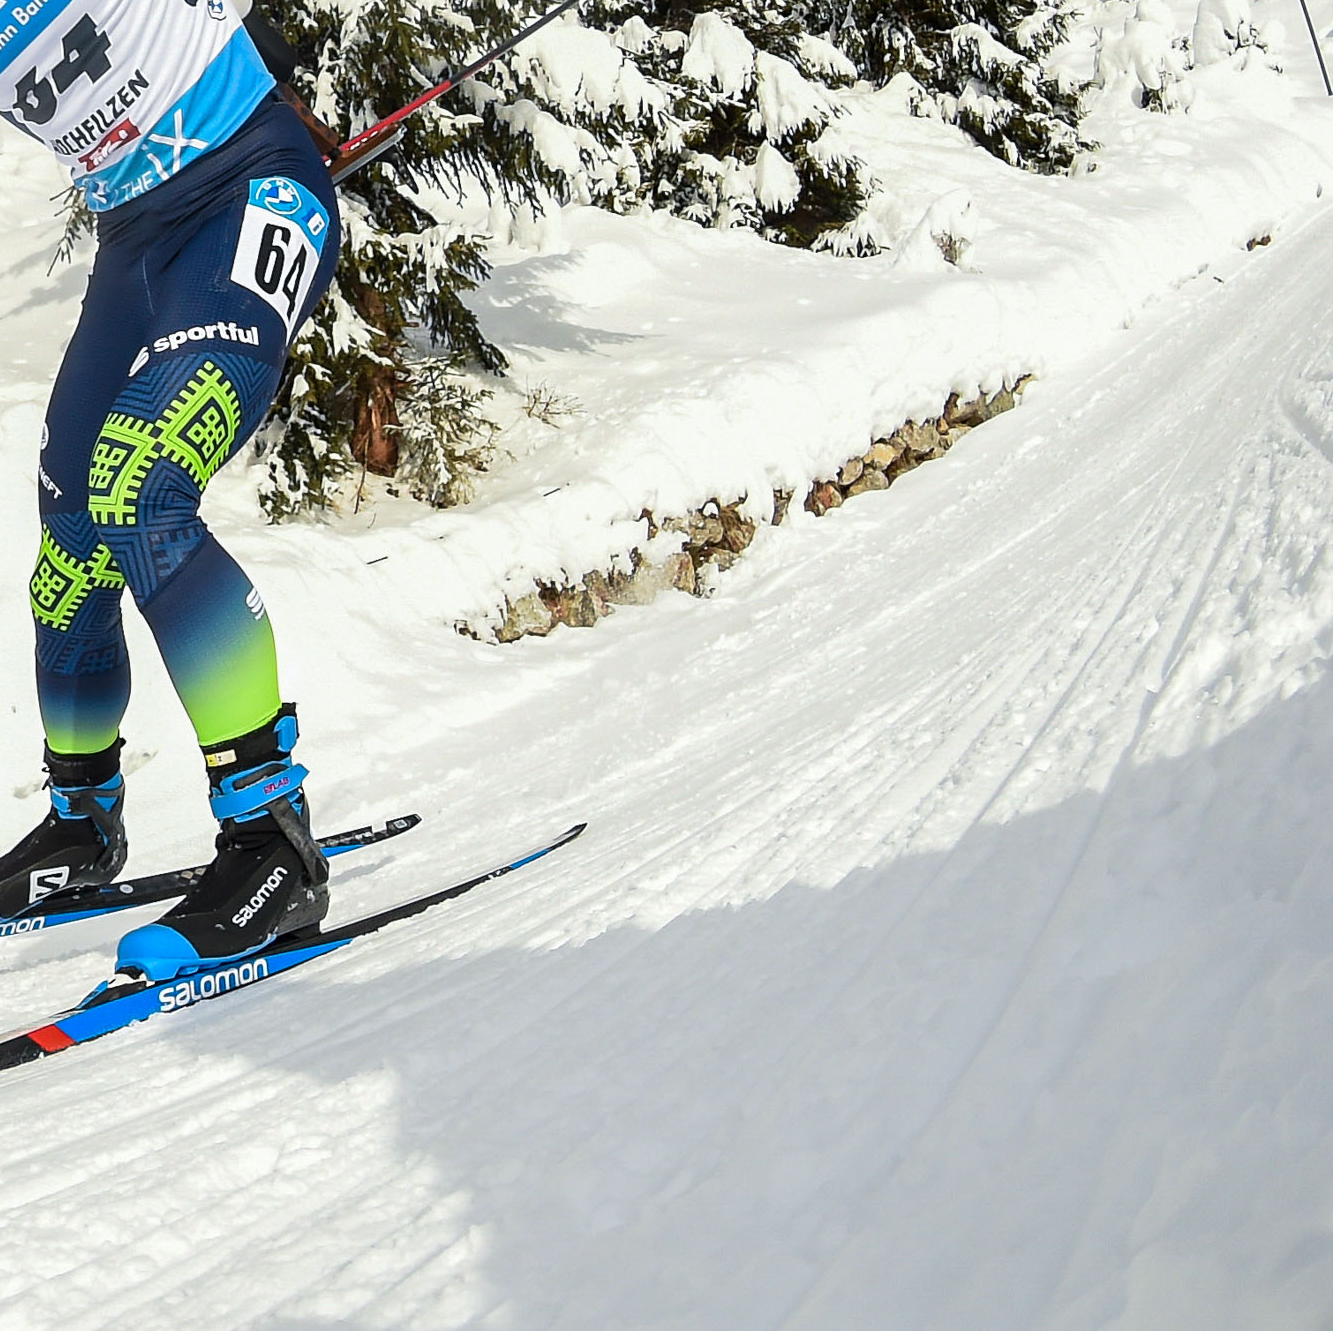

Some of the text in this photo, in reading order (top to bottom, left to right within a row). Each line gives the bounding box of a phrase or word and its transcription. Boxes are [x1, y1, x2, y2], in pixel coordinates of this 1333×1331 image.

[12, 13, 112, 125] 64
[121, 170, 153, 201] THE
[254, 223, 307, 322] 64
[153, 321, 260, 353] sportful
